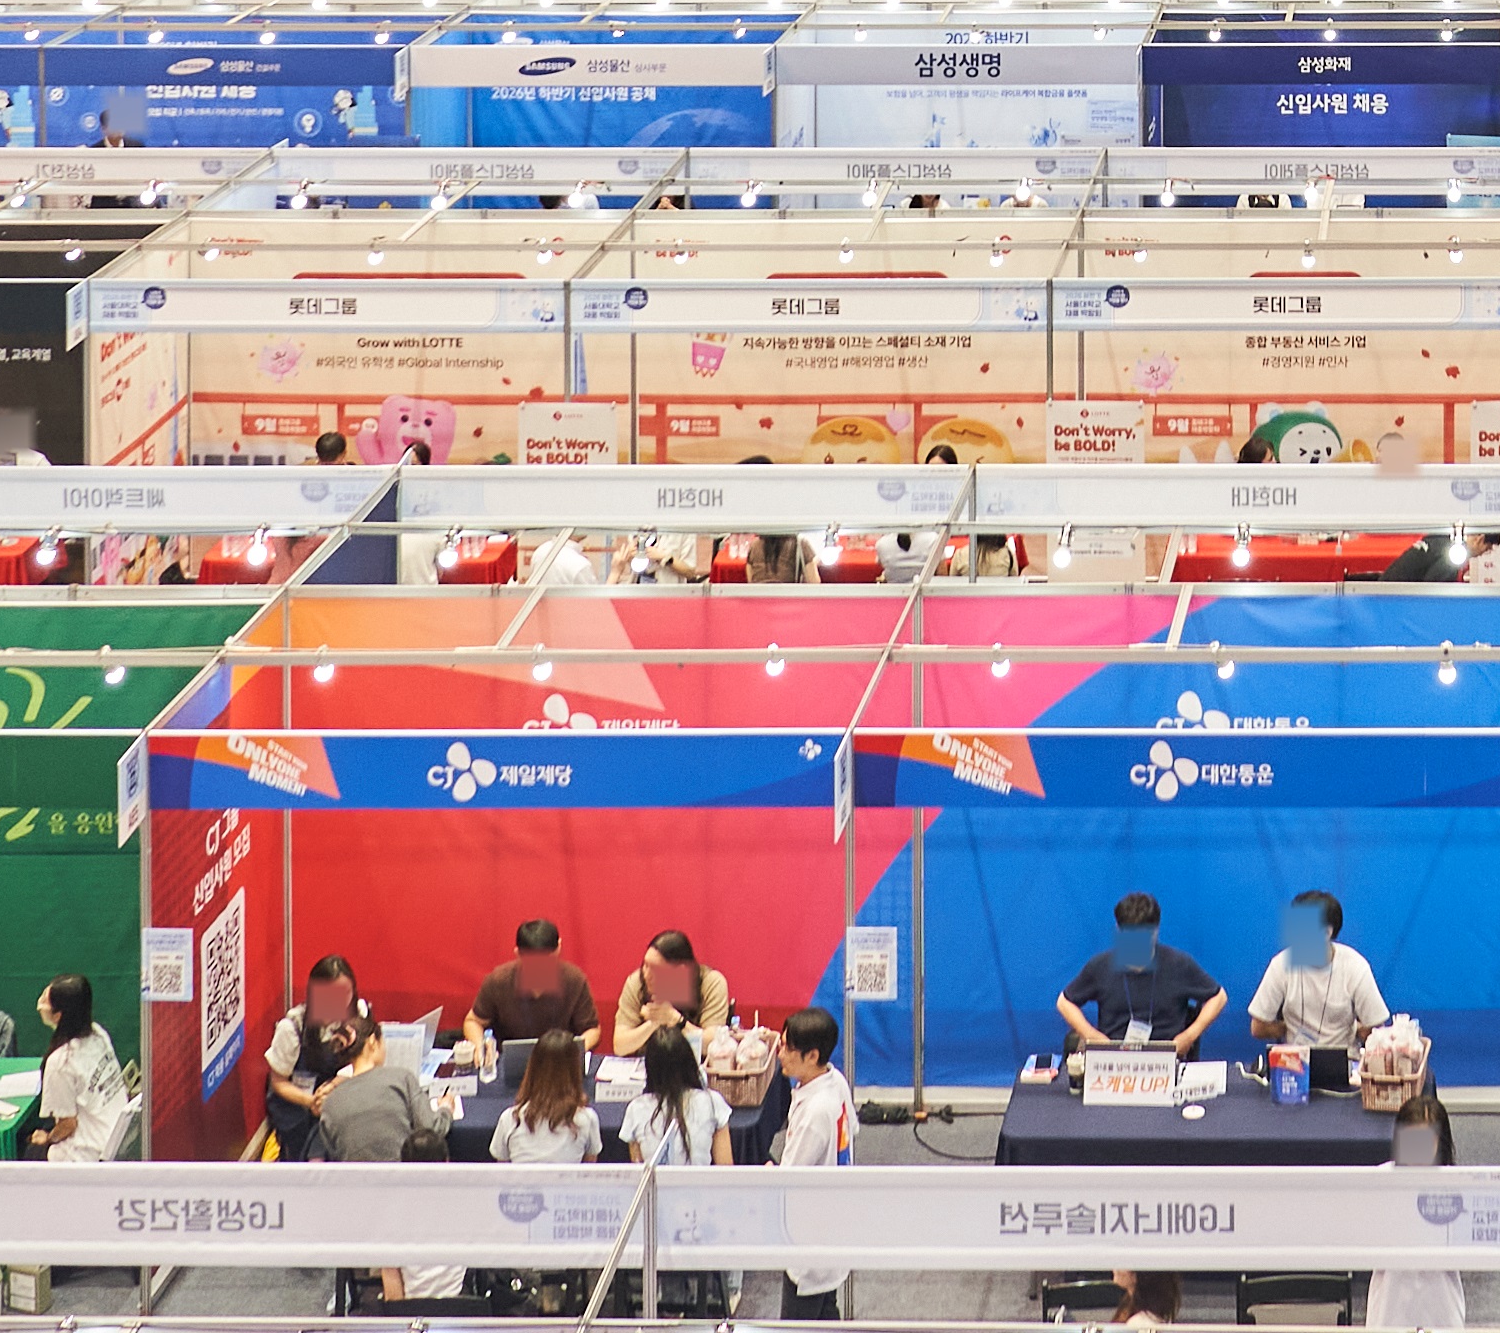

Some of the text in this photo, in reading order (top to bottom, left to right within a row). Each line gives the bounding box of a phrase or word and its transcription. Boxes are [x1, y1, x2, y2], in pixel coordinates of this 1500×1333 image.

[587, 59, 630, 73] 삼성물산
[915, 53, 1000, 78] 삼성생명
[1298, 57, 1352, 73] 삼성화재
[492, 87, 657, 101] 2026년 하반기 신입사원 공채
[1277, 93, 1389, 114] 신입사원 채용
[289, 298, 357, 315] 롯데그룹
[1253, 296, 1321, 313] 롯데그룹
[357, 338, 462, 348] Grow with LOTTE
[1245, 336, 1366, 349] 종합 부동산 서비스 기업
[1263, 355, 1348, 368] #경영지원 #인사
[1054, 425, 1137, 441] Don't Worry,
[1055, 438, 1115, 452] be BOLD!
[500, 765, 572, 786] 제일제당
[1202, 764, 1274, 786] 대한통운
[1090, 1075, 1169, 1093] 스케일 UP!
